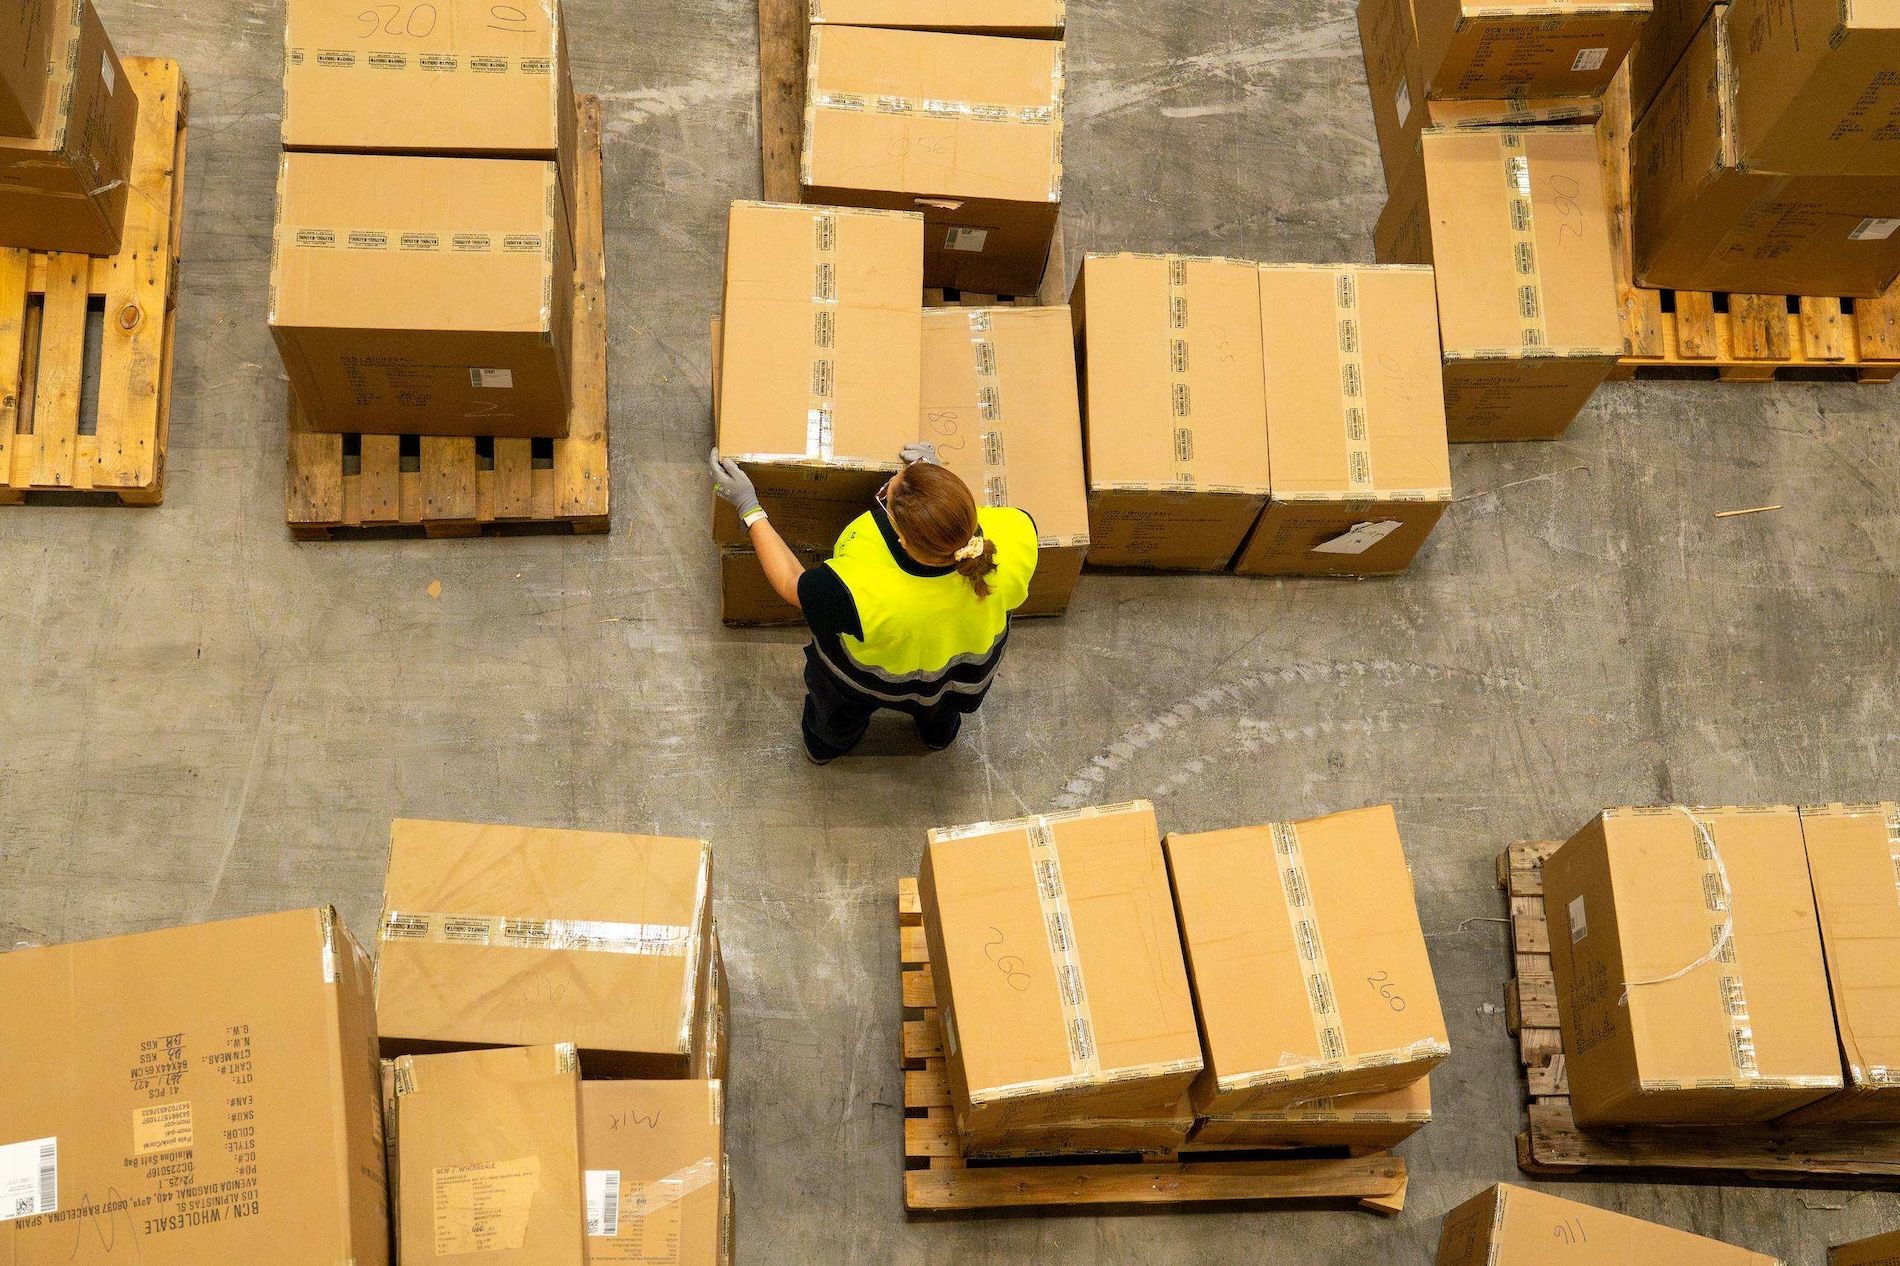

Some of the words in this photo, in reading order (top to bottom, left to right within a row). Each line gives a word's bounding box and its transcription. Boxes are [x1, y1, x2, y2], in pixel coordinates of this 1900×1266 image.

[1367, 970, 1405, 1012] 260
[141, 1040, 158, 1051] KGS
[226, 1036, 250, 1049] N.W.:
[140, 1053, 157, 1064] KGS
[148, 1088, 165, 1099] PCS
[227, 1095, 253, 1107] EAN#:
[228, 1110, 254, 1122] SKU#:
[223, 1126, 255, 1139] COLOR:
[225, 1139, 255, 1152] STYLE:
[124, 1157, 139, 1168] Bag
[141, 1155, 158, 1166] Soft
[220, 1177, 257, 1191] AVENIDA
[176, 1183, 218, 1199] DIAGONAL
[242, 1189, 258, 1201] LOS
[102, 1199, 128, 1214] 08037
[176, 1203, 186, 1213] SL
[189, 1193, 239, 1211] ALPINISTAS
[45, 1204, 100, 1224] BARCELONA,
[233, 1201, 259, 1219] BCN
[15, 1215, 42, 1230] SPAIN
[145, 1208, 221, 1235] WHOLESALE
